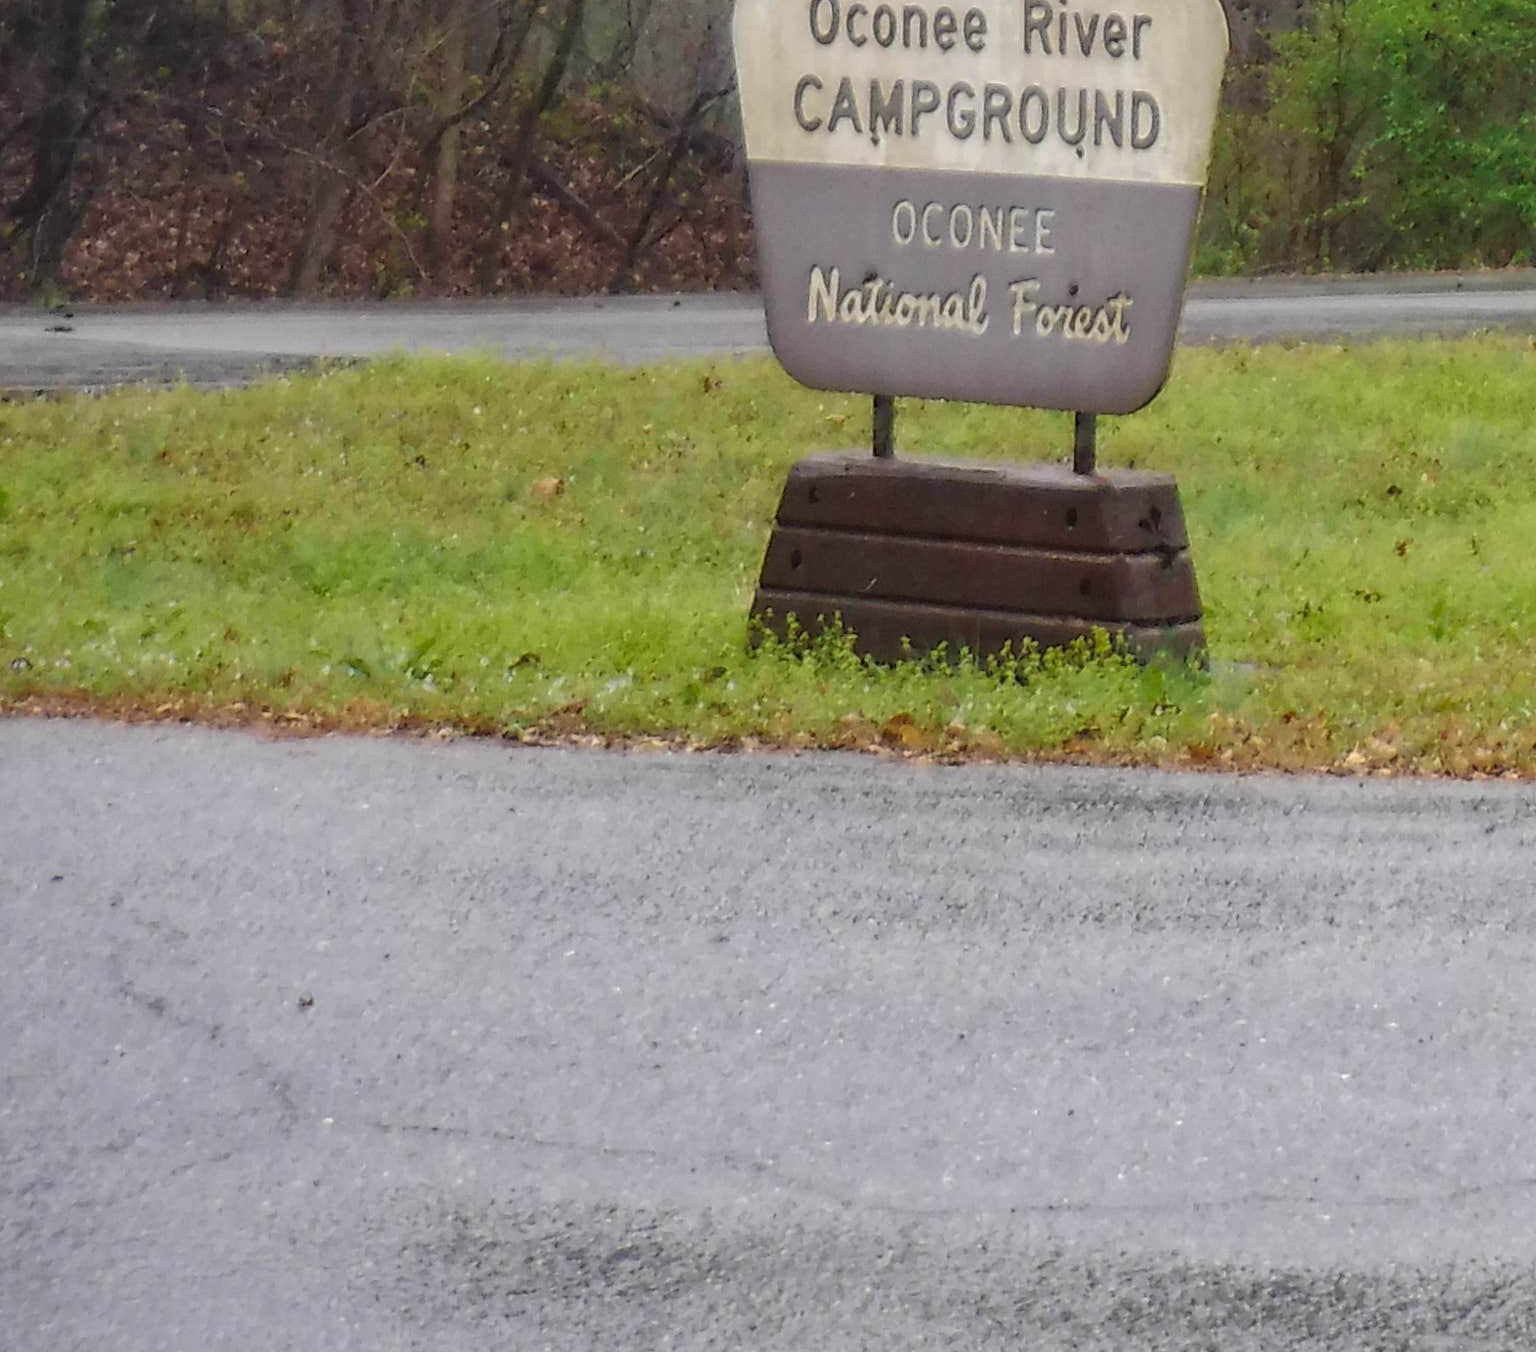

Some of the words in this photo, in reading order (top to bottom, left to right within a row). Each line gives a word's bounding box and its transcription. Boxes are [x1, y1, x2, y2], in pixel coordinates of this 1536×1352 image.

[793, 74, 1162, 151] CAMPGROUND
[892, 200, 1056, 256] OCONEE
[807, 264, 989, 336] National
[1009, 277, 1133, 345] Forest
